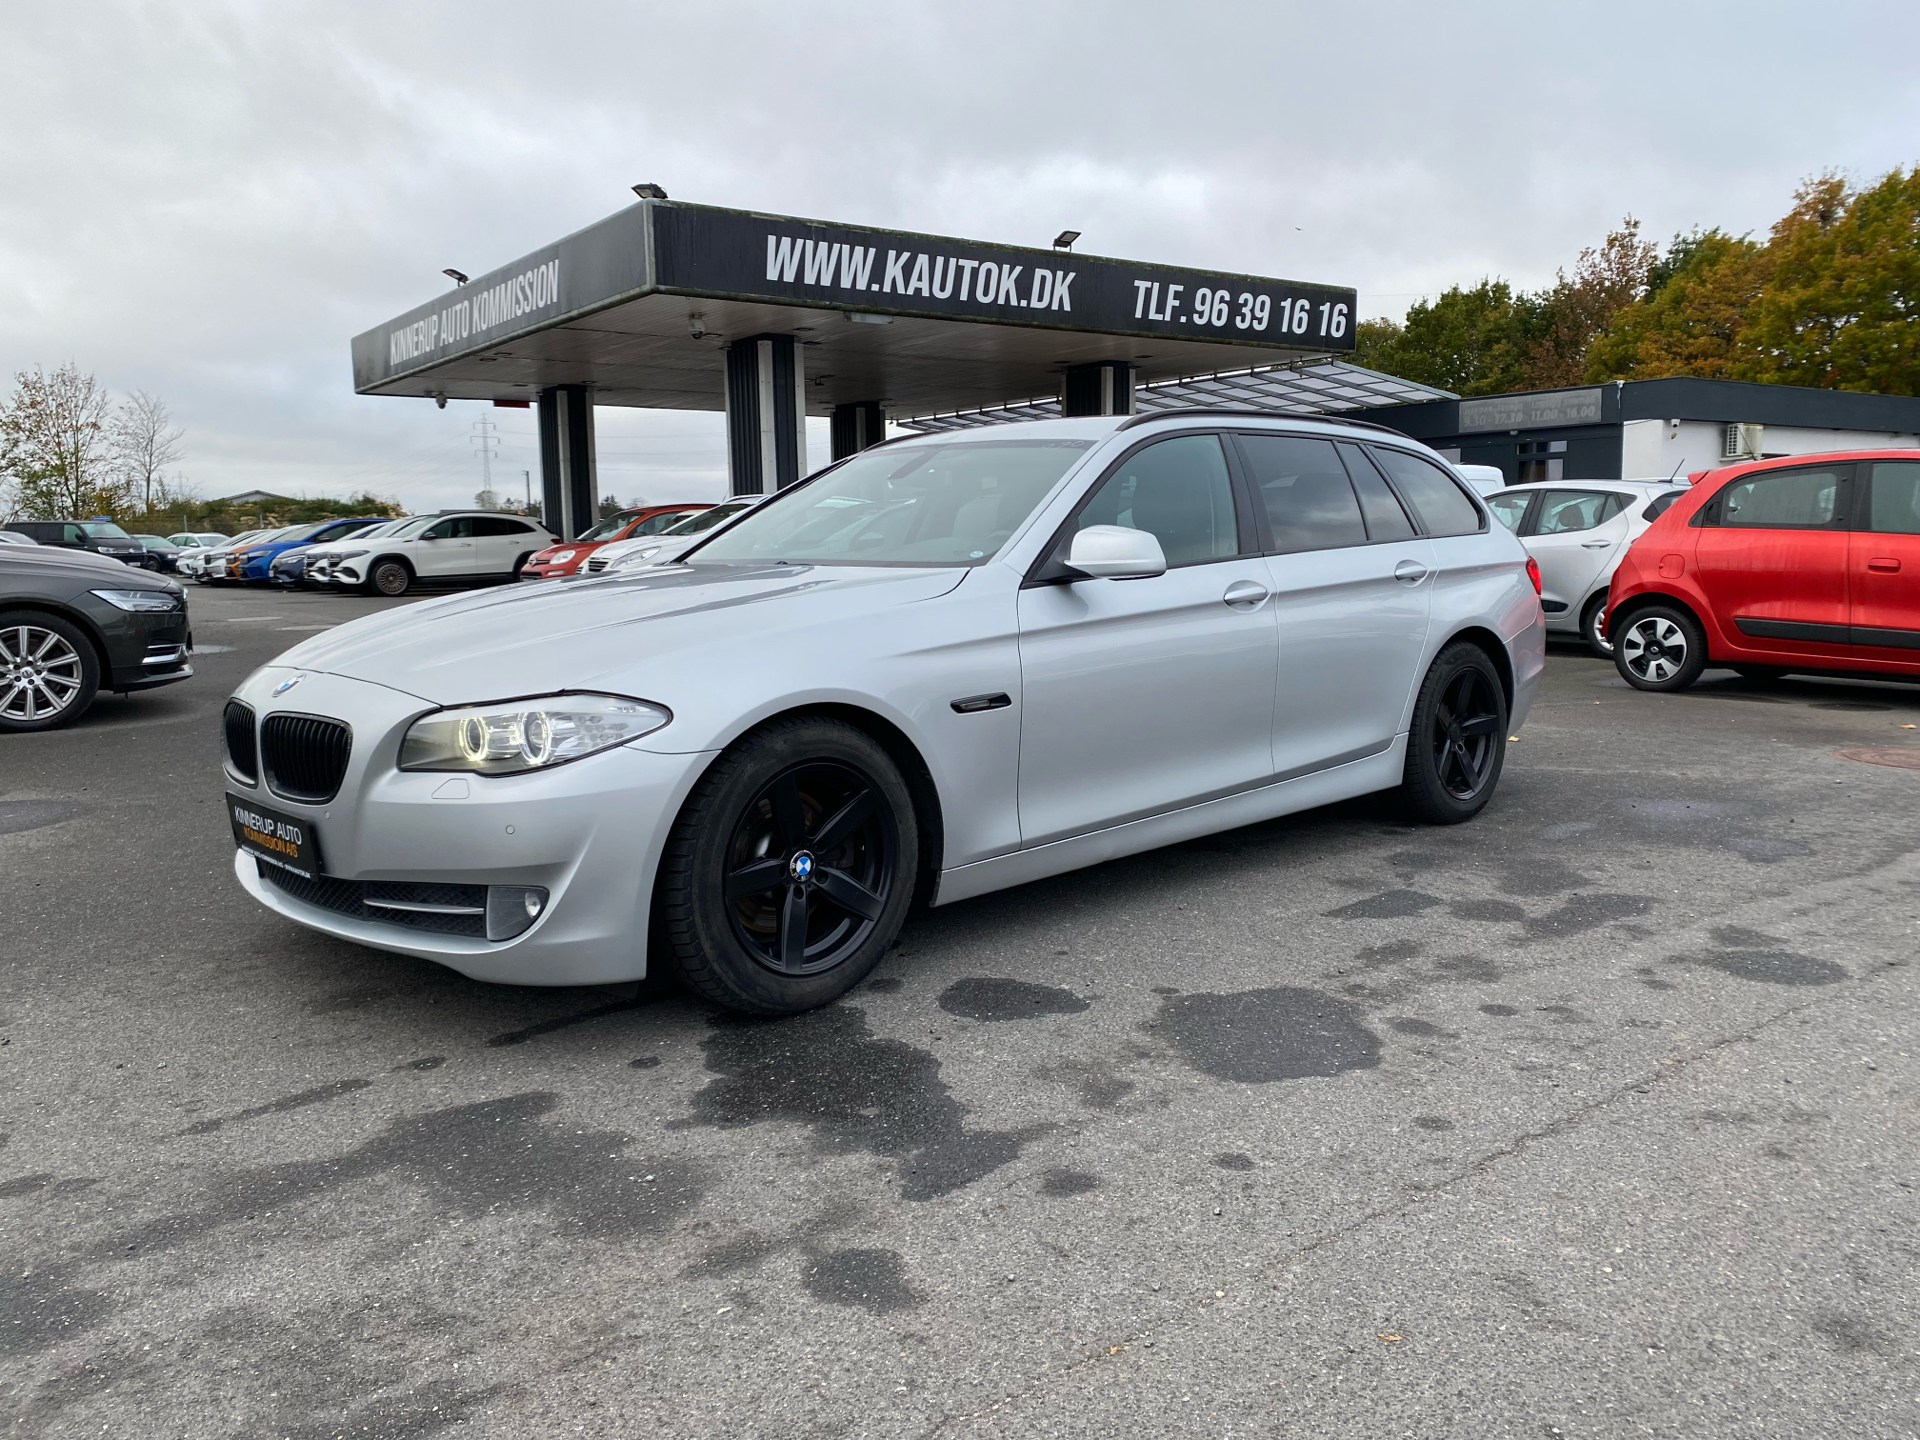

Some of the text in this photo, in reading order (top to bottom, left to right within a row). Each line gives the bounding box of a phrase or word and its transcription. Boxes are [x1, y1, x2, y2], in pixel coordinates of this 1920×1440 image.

[765, 234, 1076, 312] WWW.KAUTOK.DK
[390, 259, 559, 366] KINNERUP AUTO KOMMISSION
[1134, 279, 1348, 338] TLF. 96 39 16 16
[1463, 415, 1486, 427] 9.30
[1531, 408, 1558, 421] 11.00
[1566, 405, 1595, 419] 16.00
[234, 805, 302, 845] KINNERUP AUTO
